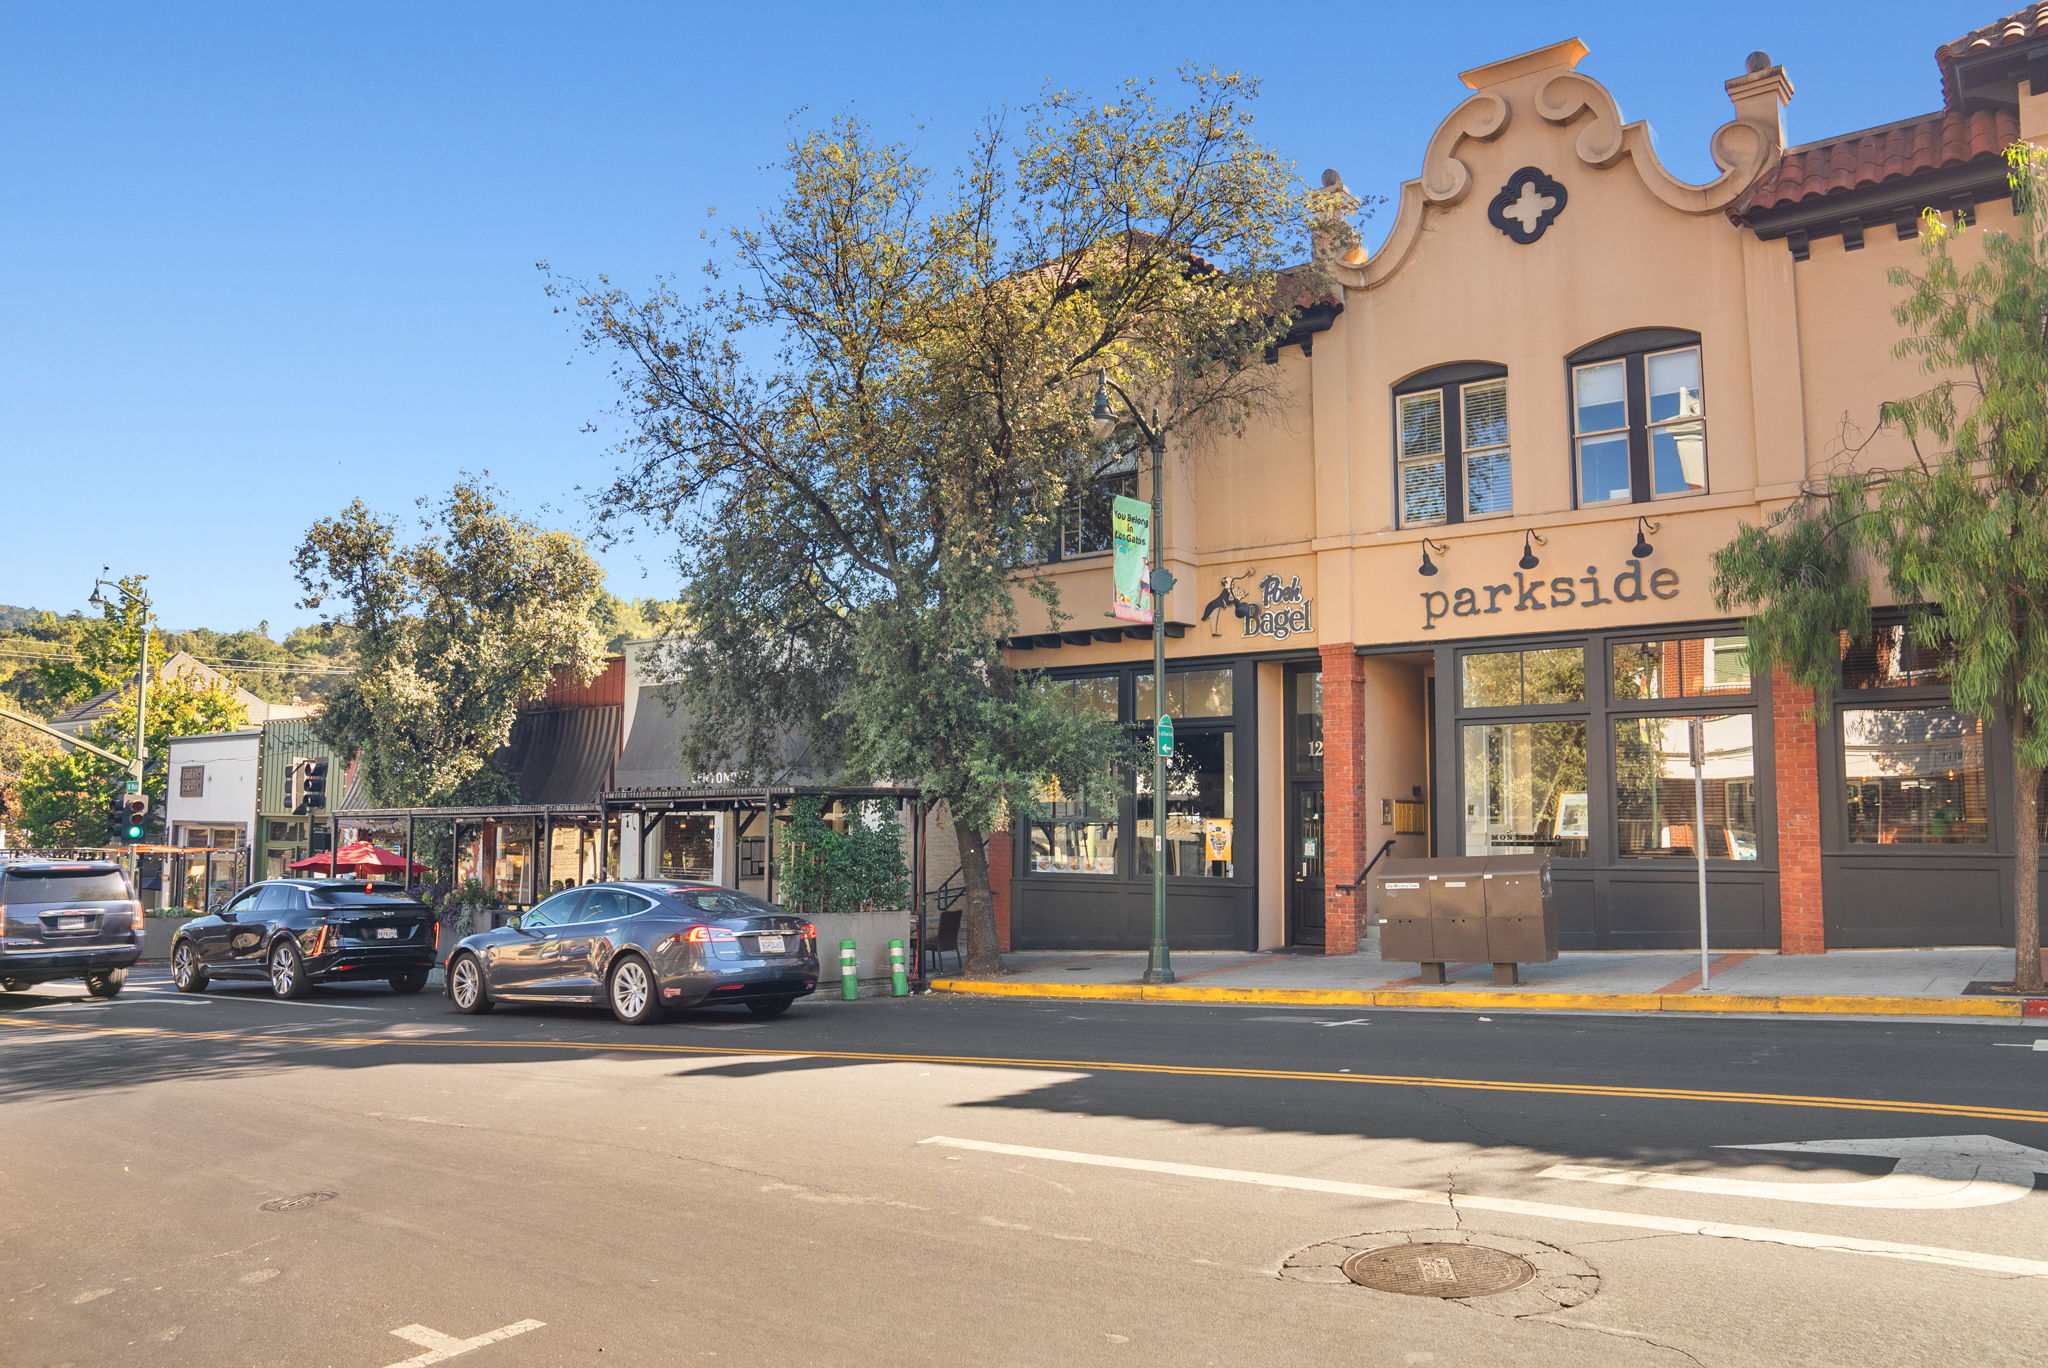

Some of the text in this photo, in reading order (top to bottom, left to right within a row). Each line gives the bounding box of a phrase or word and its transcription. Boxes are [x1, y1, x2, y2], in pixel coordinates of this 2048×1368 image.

[1114, 510, 1149, 528] You Belong
[1127, 523, 1134, 533] in
[1115, 530, 1147, 546] Los Gatos
[1260, 574, 1303, 608] Posh
[1420, 559, 1680, 630] parkside
[1242, 598, 1315, 640] Bagel
